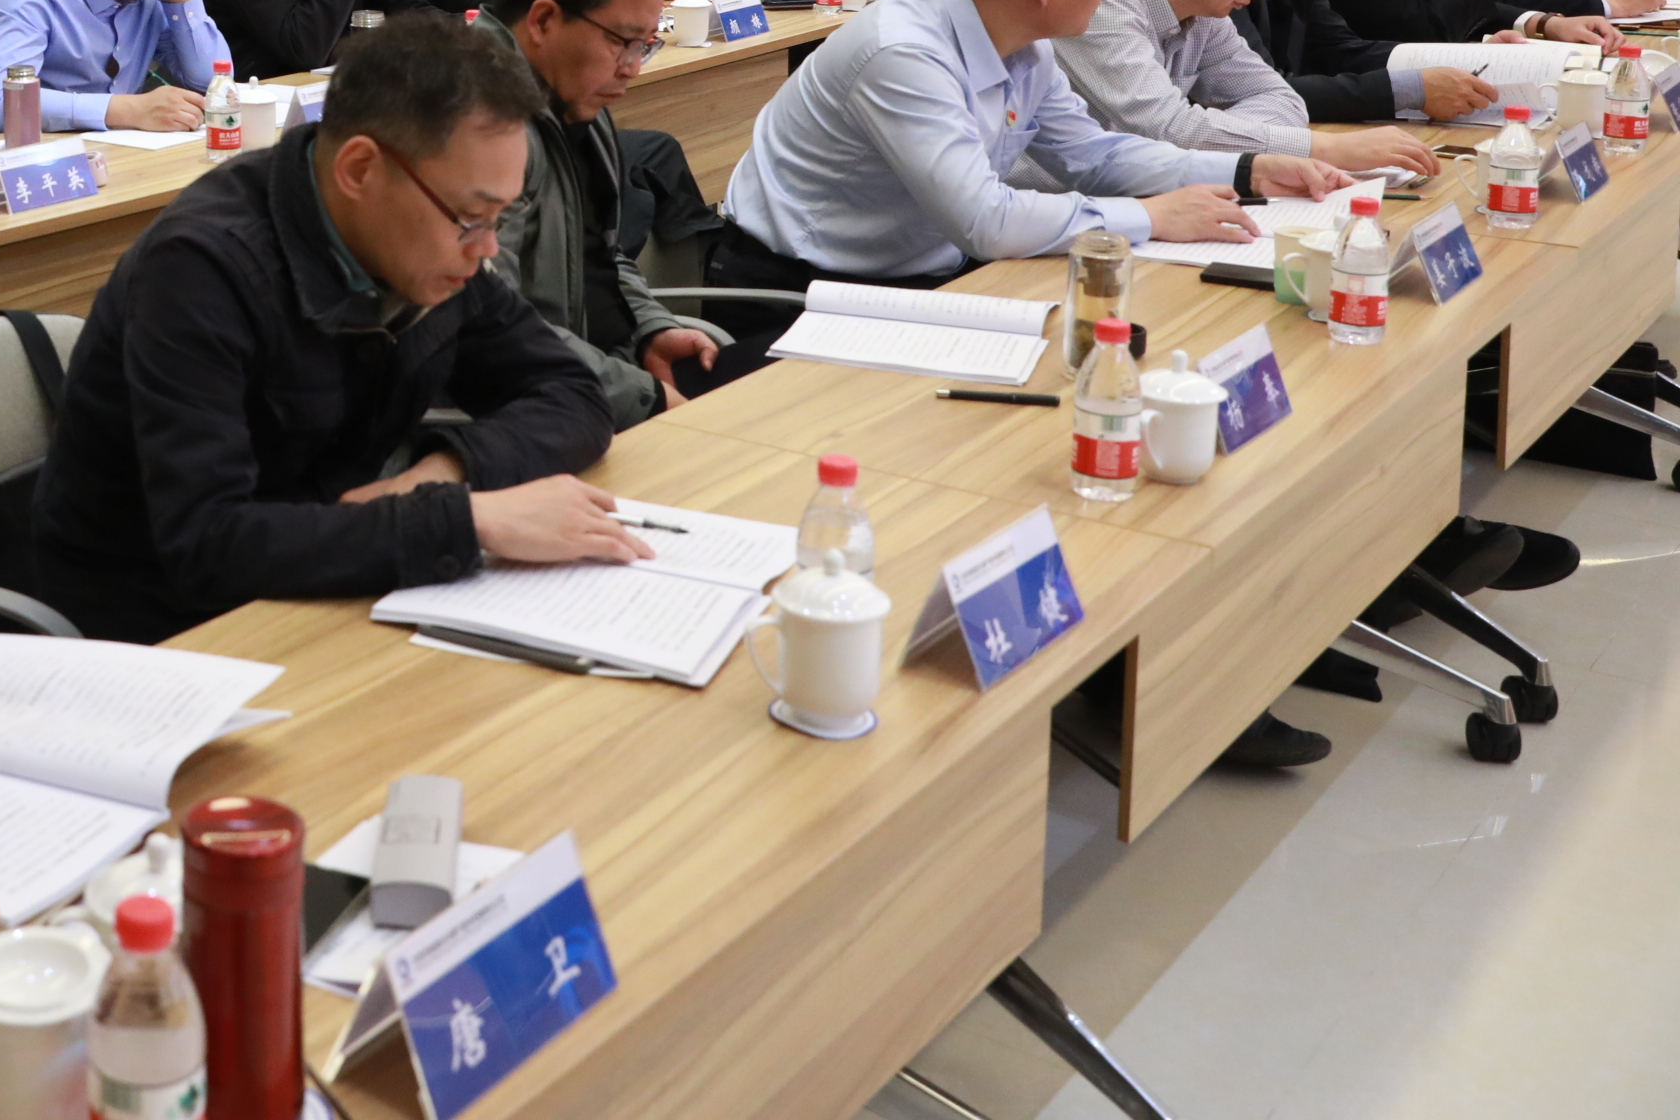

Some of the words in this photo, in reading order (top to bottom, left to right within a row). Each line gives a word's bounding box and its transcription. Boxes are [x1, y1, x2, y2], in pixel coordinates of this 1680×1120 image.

[16, 166, 85, 204] 李平英
[449, 935, 582, 1073] 唐卫
